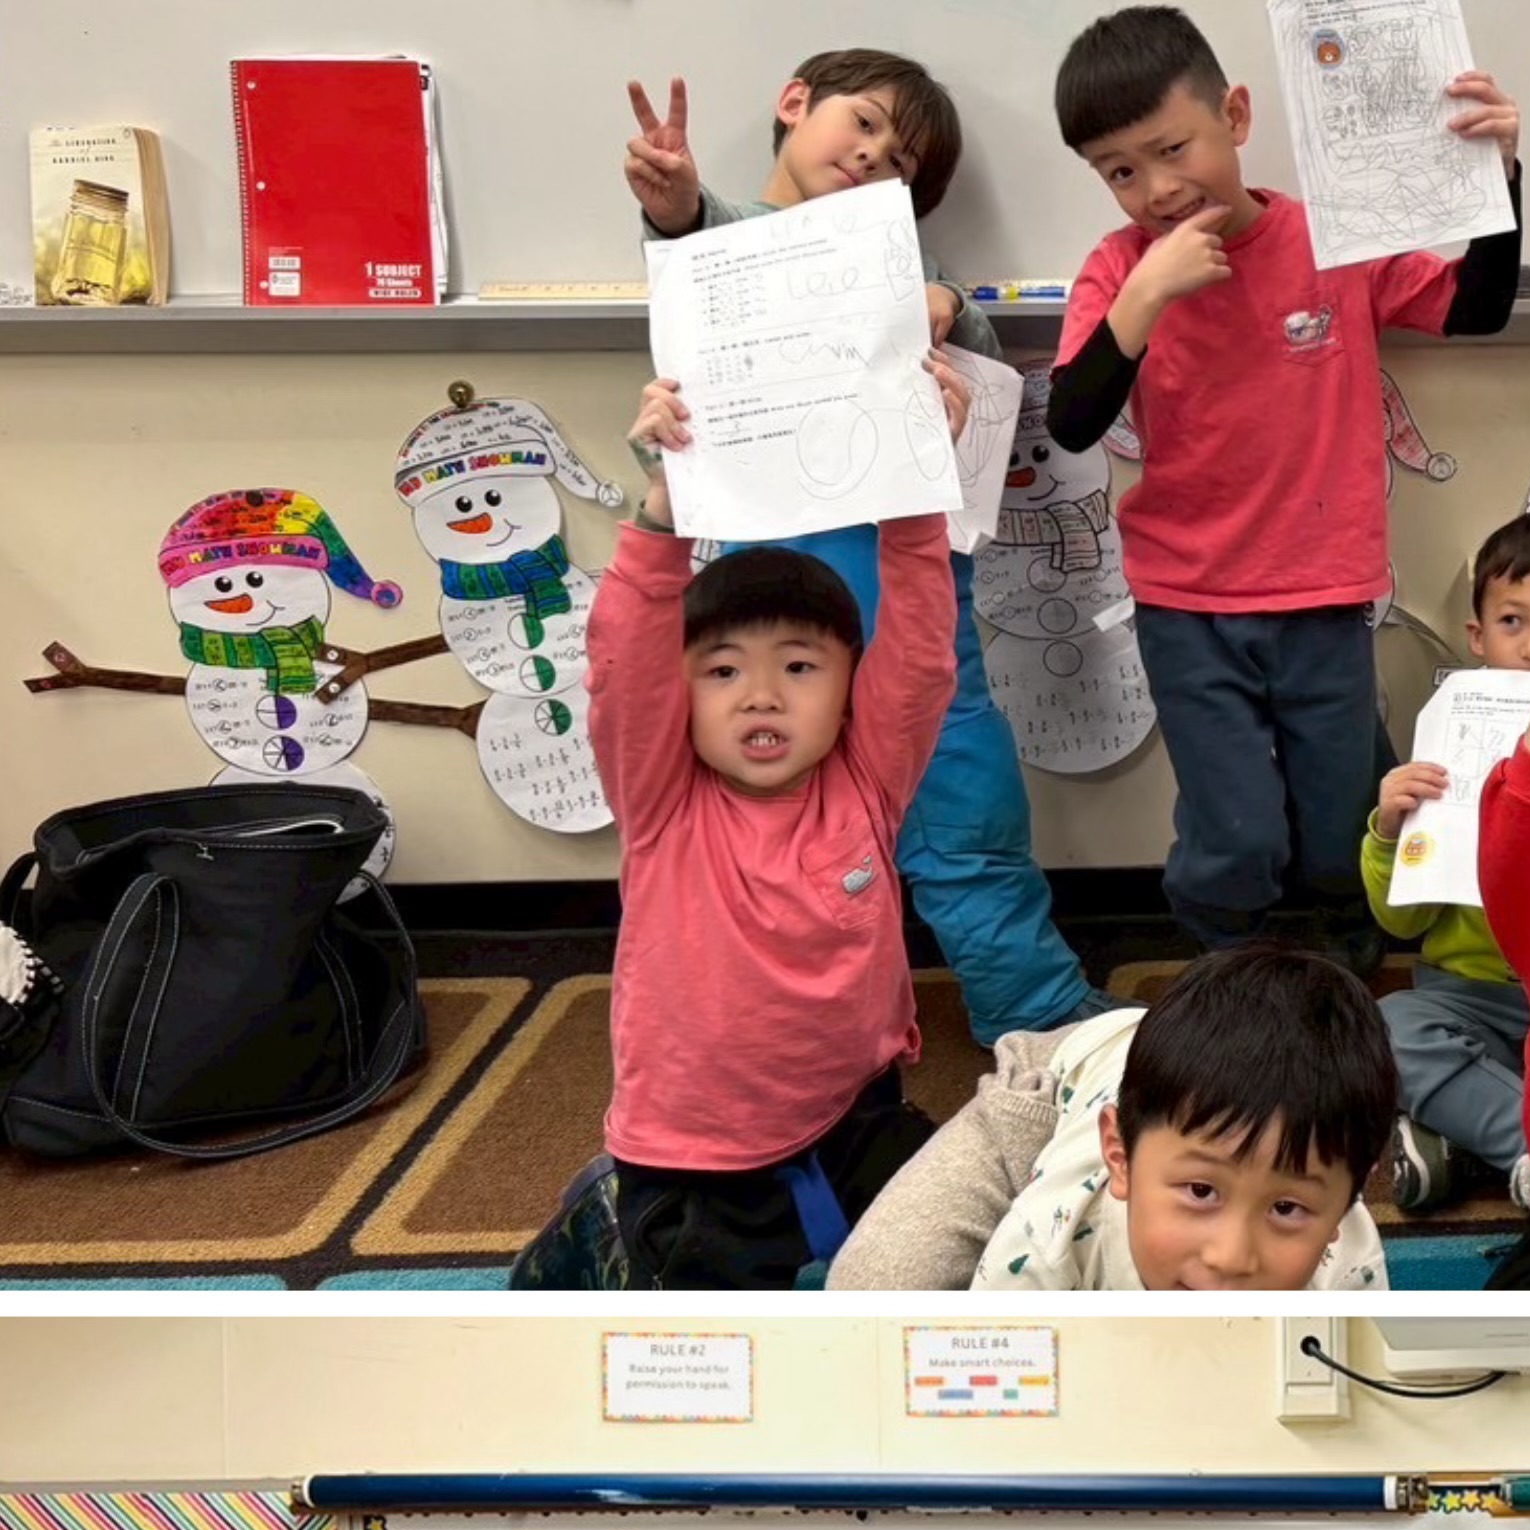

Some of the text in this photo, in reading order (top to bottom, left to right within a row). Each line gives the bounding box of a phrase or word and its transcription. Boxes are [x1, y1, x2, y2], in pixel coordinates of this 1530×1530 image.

[365, 261, 422, 278] 1 SUBJECT
[423, 458, 467, 482] MATH
[469, 450, 547, 470] SNOWMAN
[189, 544, 233, 564] MATH
[237, 542, 323, 560] SNOWMAN
[650, 1343, 706, 1357] RULE #2
[951, 1337, 1010, 1350] RULE #4
[928, 1358, 1036, 1368] Make smart choices.
[629, 1364, 730, 1376] Raise your hand for
[625, 1380, 684, 1390] permission
[685, 1380, 697, 1390] to
